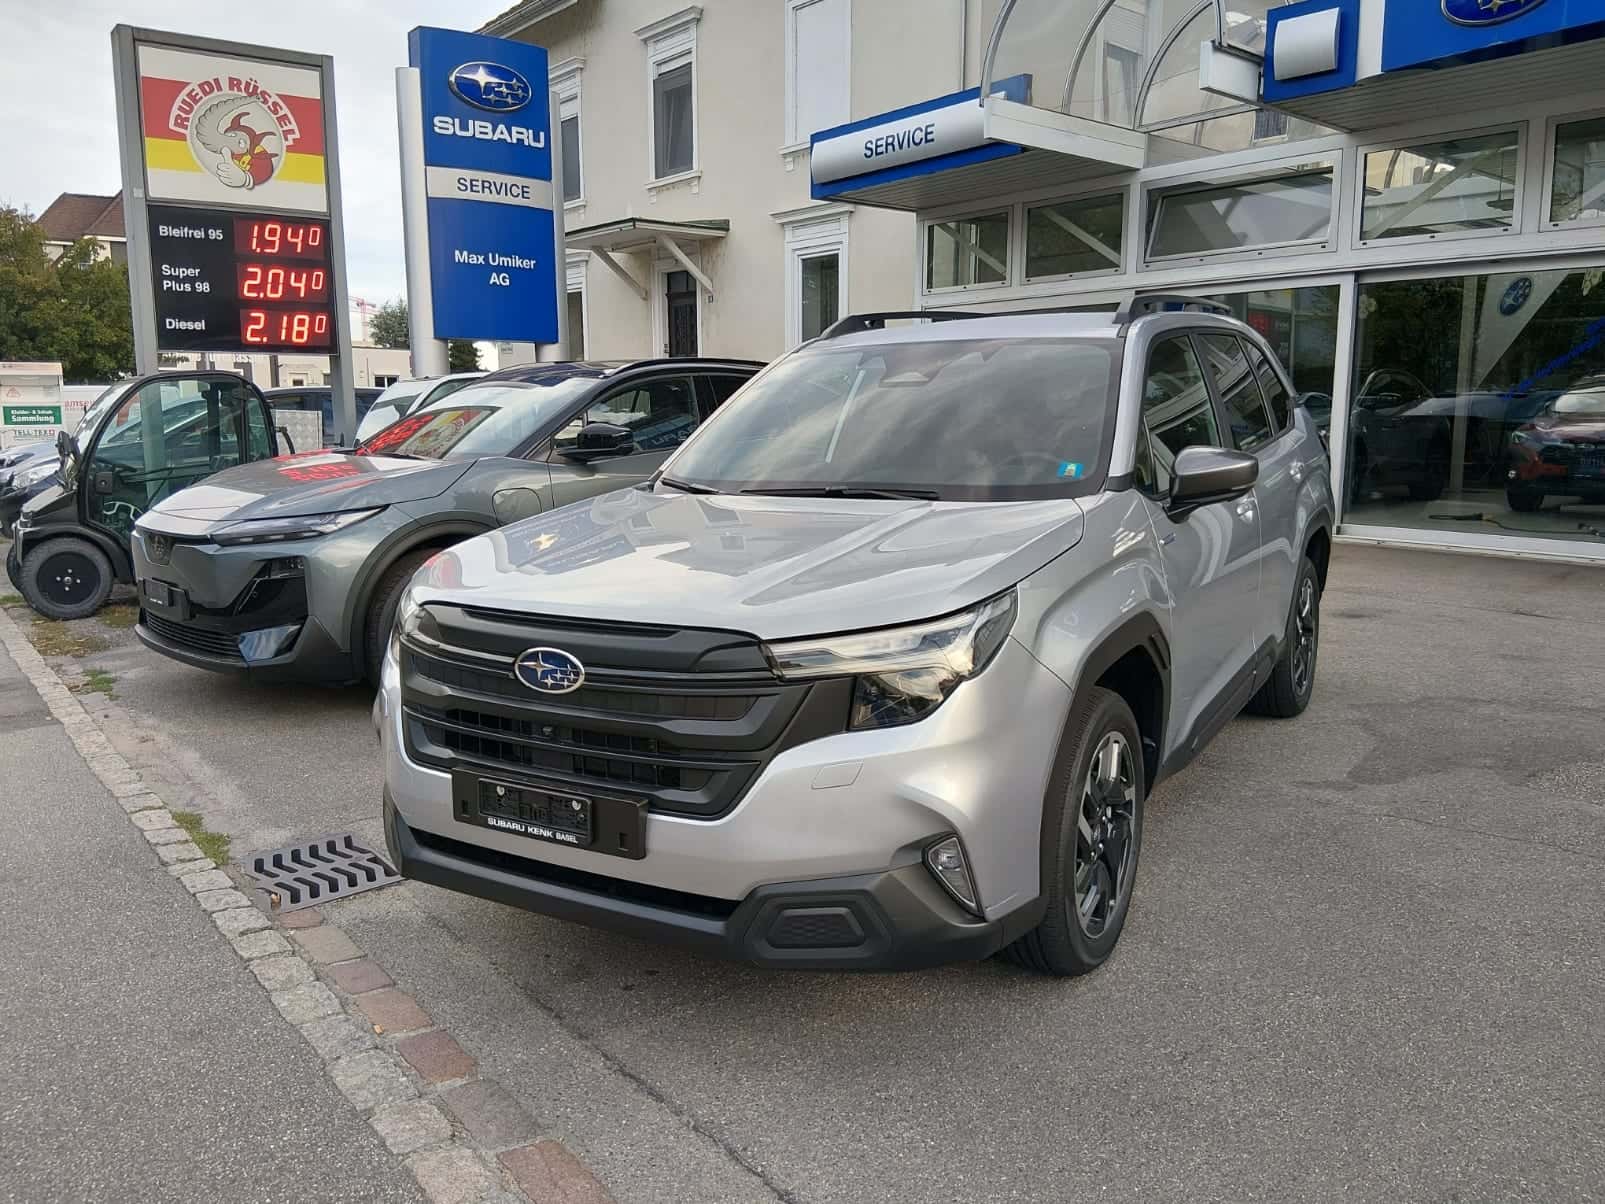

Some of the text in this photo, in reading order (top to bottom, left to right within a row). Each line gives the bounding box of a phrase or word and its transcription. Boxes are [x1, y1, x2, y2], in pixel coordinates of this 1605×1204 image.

[173, 76, 300, 142] RUEDI RÜSSEL
[433, 117, 545, 148] SUBARU
[864, 123, 935, 158] SERVICE
[456, 177, 531, 200] SERVICE
[159, 225, 224, 240] Bleifrei 95
[454, 249, 536, 270] Max Umiker
[161, 264, 201, 279] Super
[489, 272, 510, 286] AG
[163, 280, 211, 293] Plus 98
[165, 318, 206, 331] Diesel
[11, 415, 55, 423] Sammlung
[488, 817, 579, 843] SUBARU KENK BASEL
